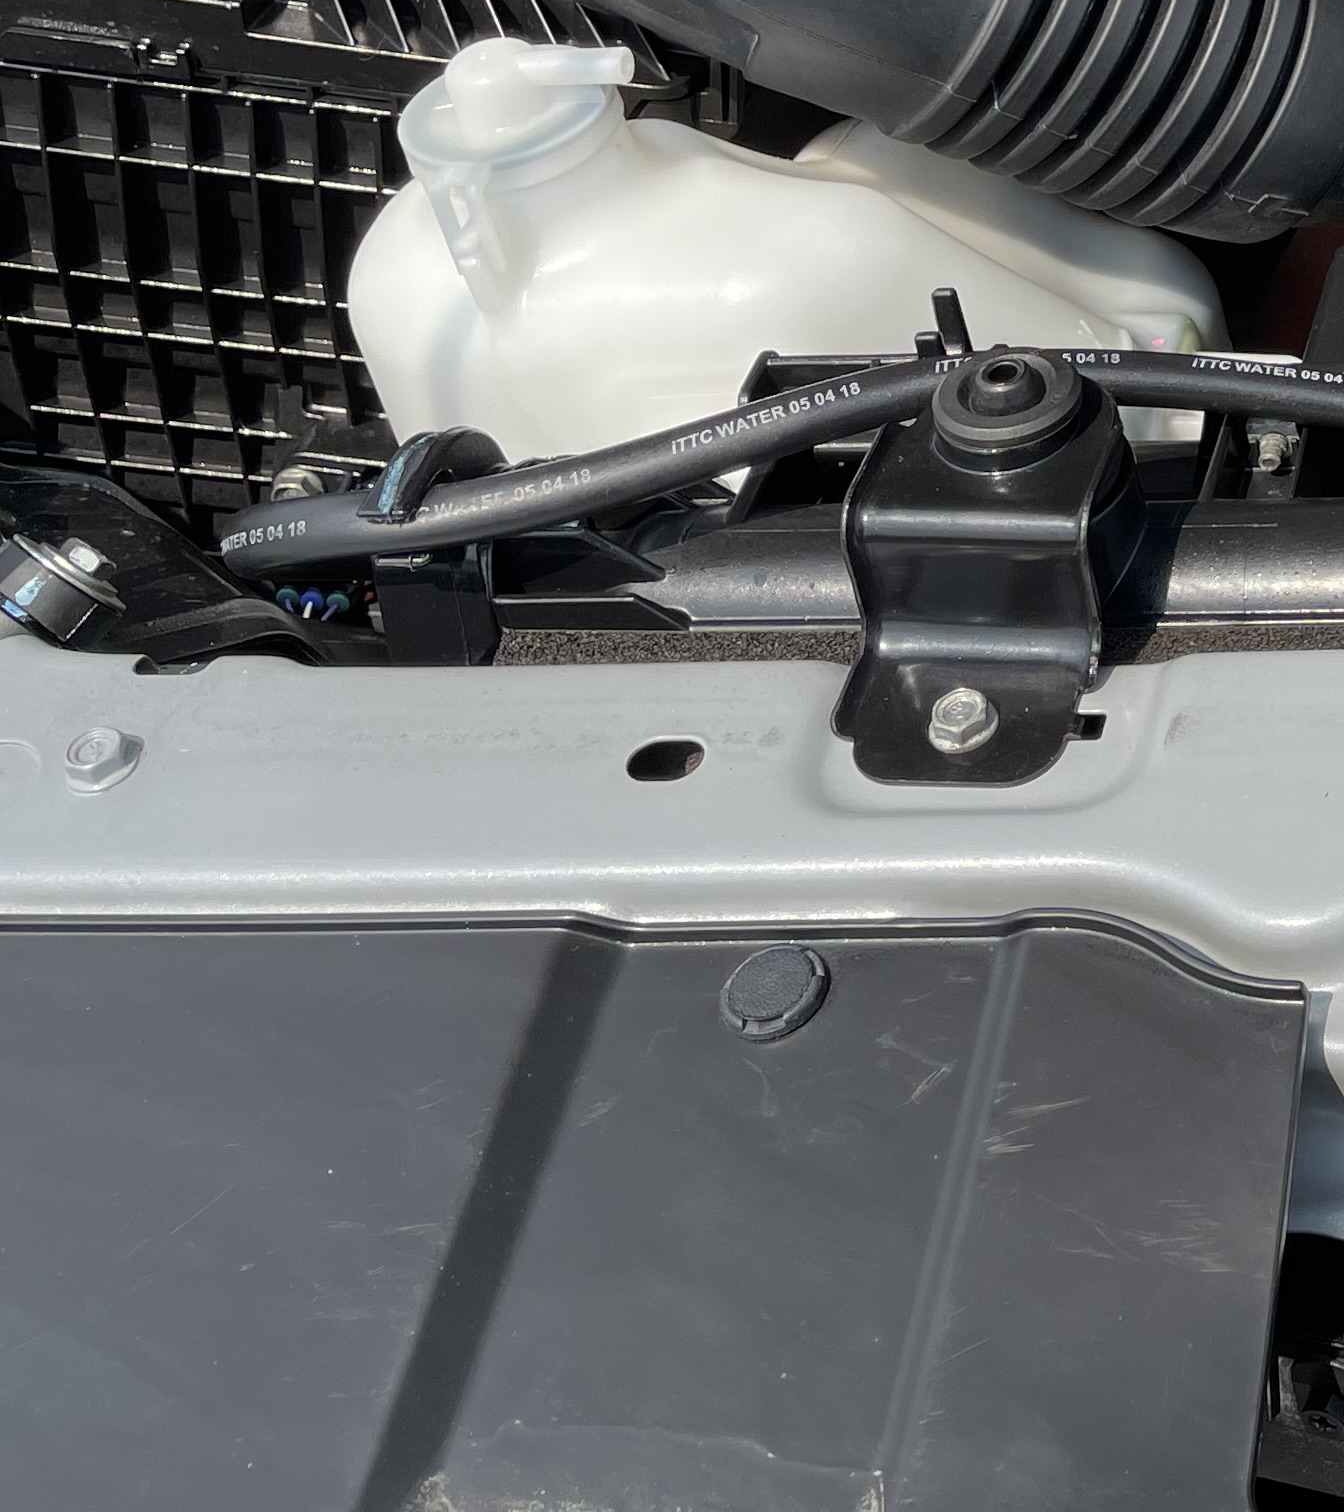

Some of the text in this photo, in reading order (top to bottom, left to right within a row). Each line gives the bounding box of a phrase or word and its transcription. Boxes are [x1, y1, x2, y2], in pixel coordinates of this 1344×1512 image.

[1076, 353, 1096, 364] 04
[1101, 352, 1121, 364] 18
[1234, 361, 1297, 379] WATER
[1301, 369, 1320, 382] 05
[1324, 372, 1343, 385] 04
[715, 405, 786, 439] WATER
[789, 396, 811, 414] 05
[814, 389, 836, 406] 04
[839, 382, 861, 396] 18
[569, 468, 592, 486] 18
[249, 526, 265, 545] 05
[267, 523, 284, 542] 04
[287, 520, 306, 537] 18
